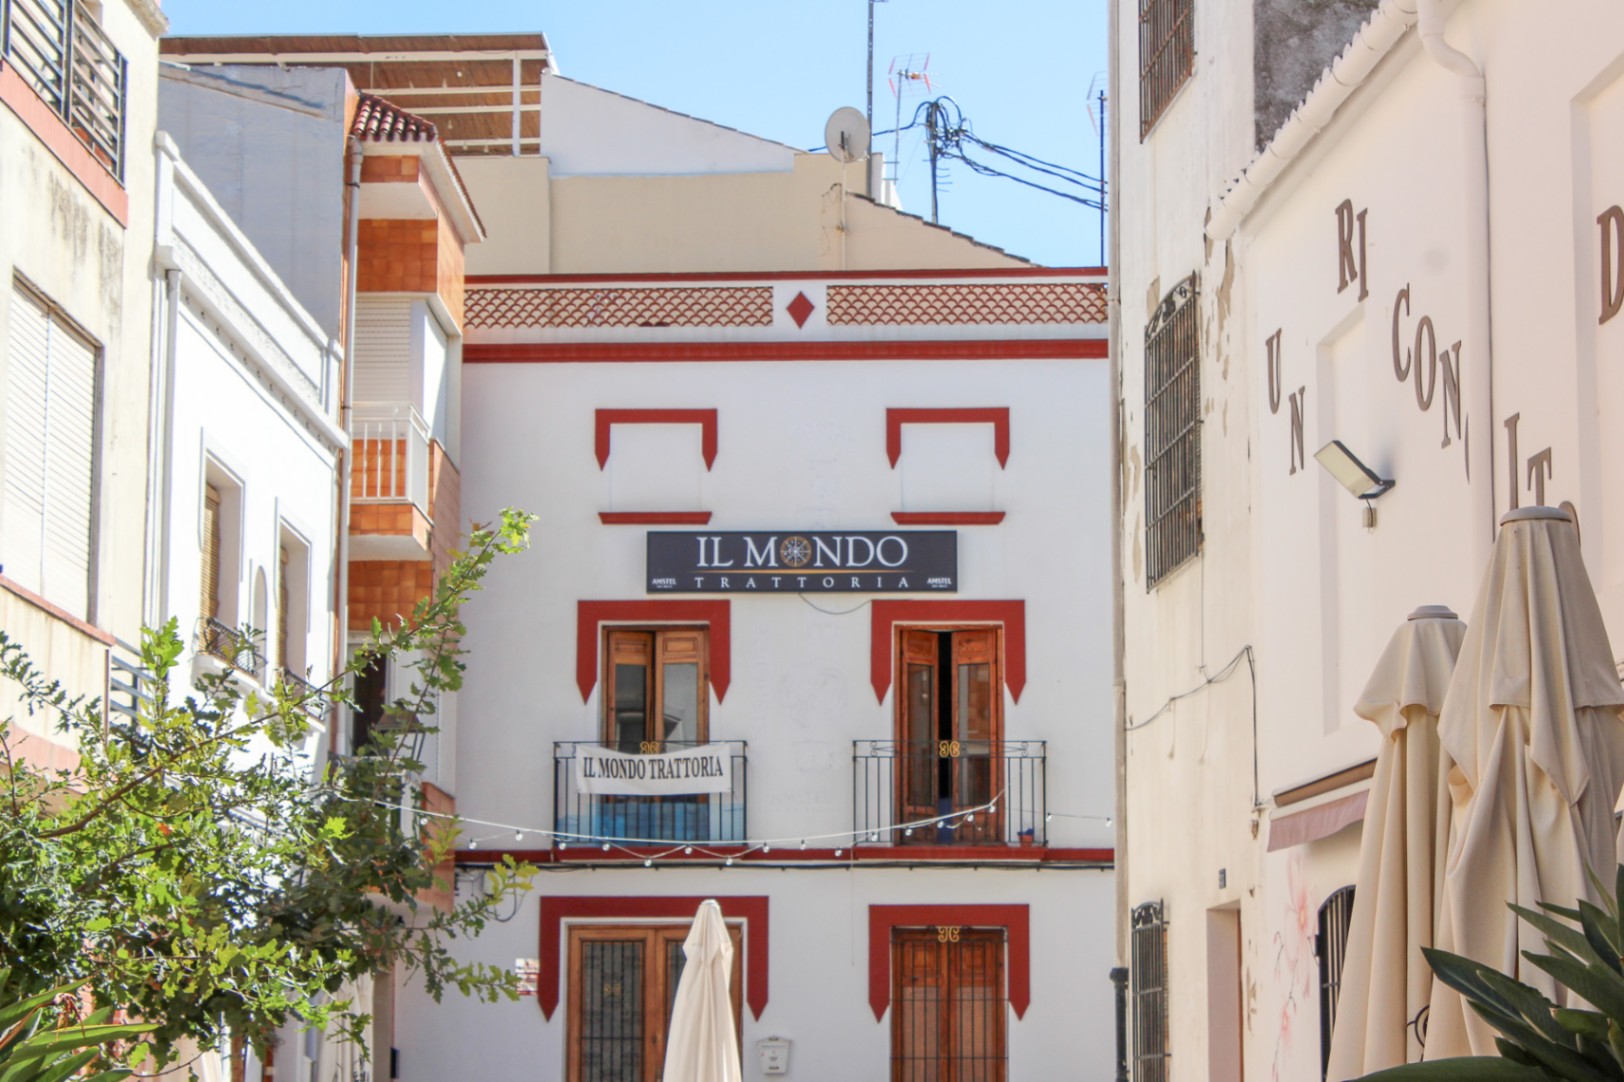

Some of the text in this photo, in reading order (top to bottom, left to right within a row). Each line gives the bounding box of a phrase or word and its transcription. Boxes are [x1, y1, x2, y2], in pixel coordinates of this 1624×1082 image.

[1265, 327, 1305, 476] UN
[696, 535, 909, 568] IL MONDO
[651, 577, 678, 585] AMSTEL
[694, 576, 909, 589] TRATTORIA
[926, 577, 953, 585] AMSTEL
[583, 755, 724, 780] IL MONDO TRATTORIA
